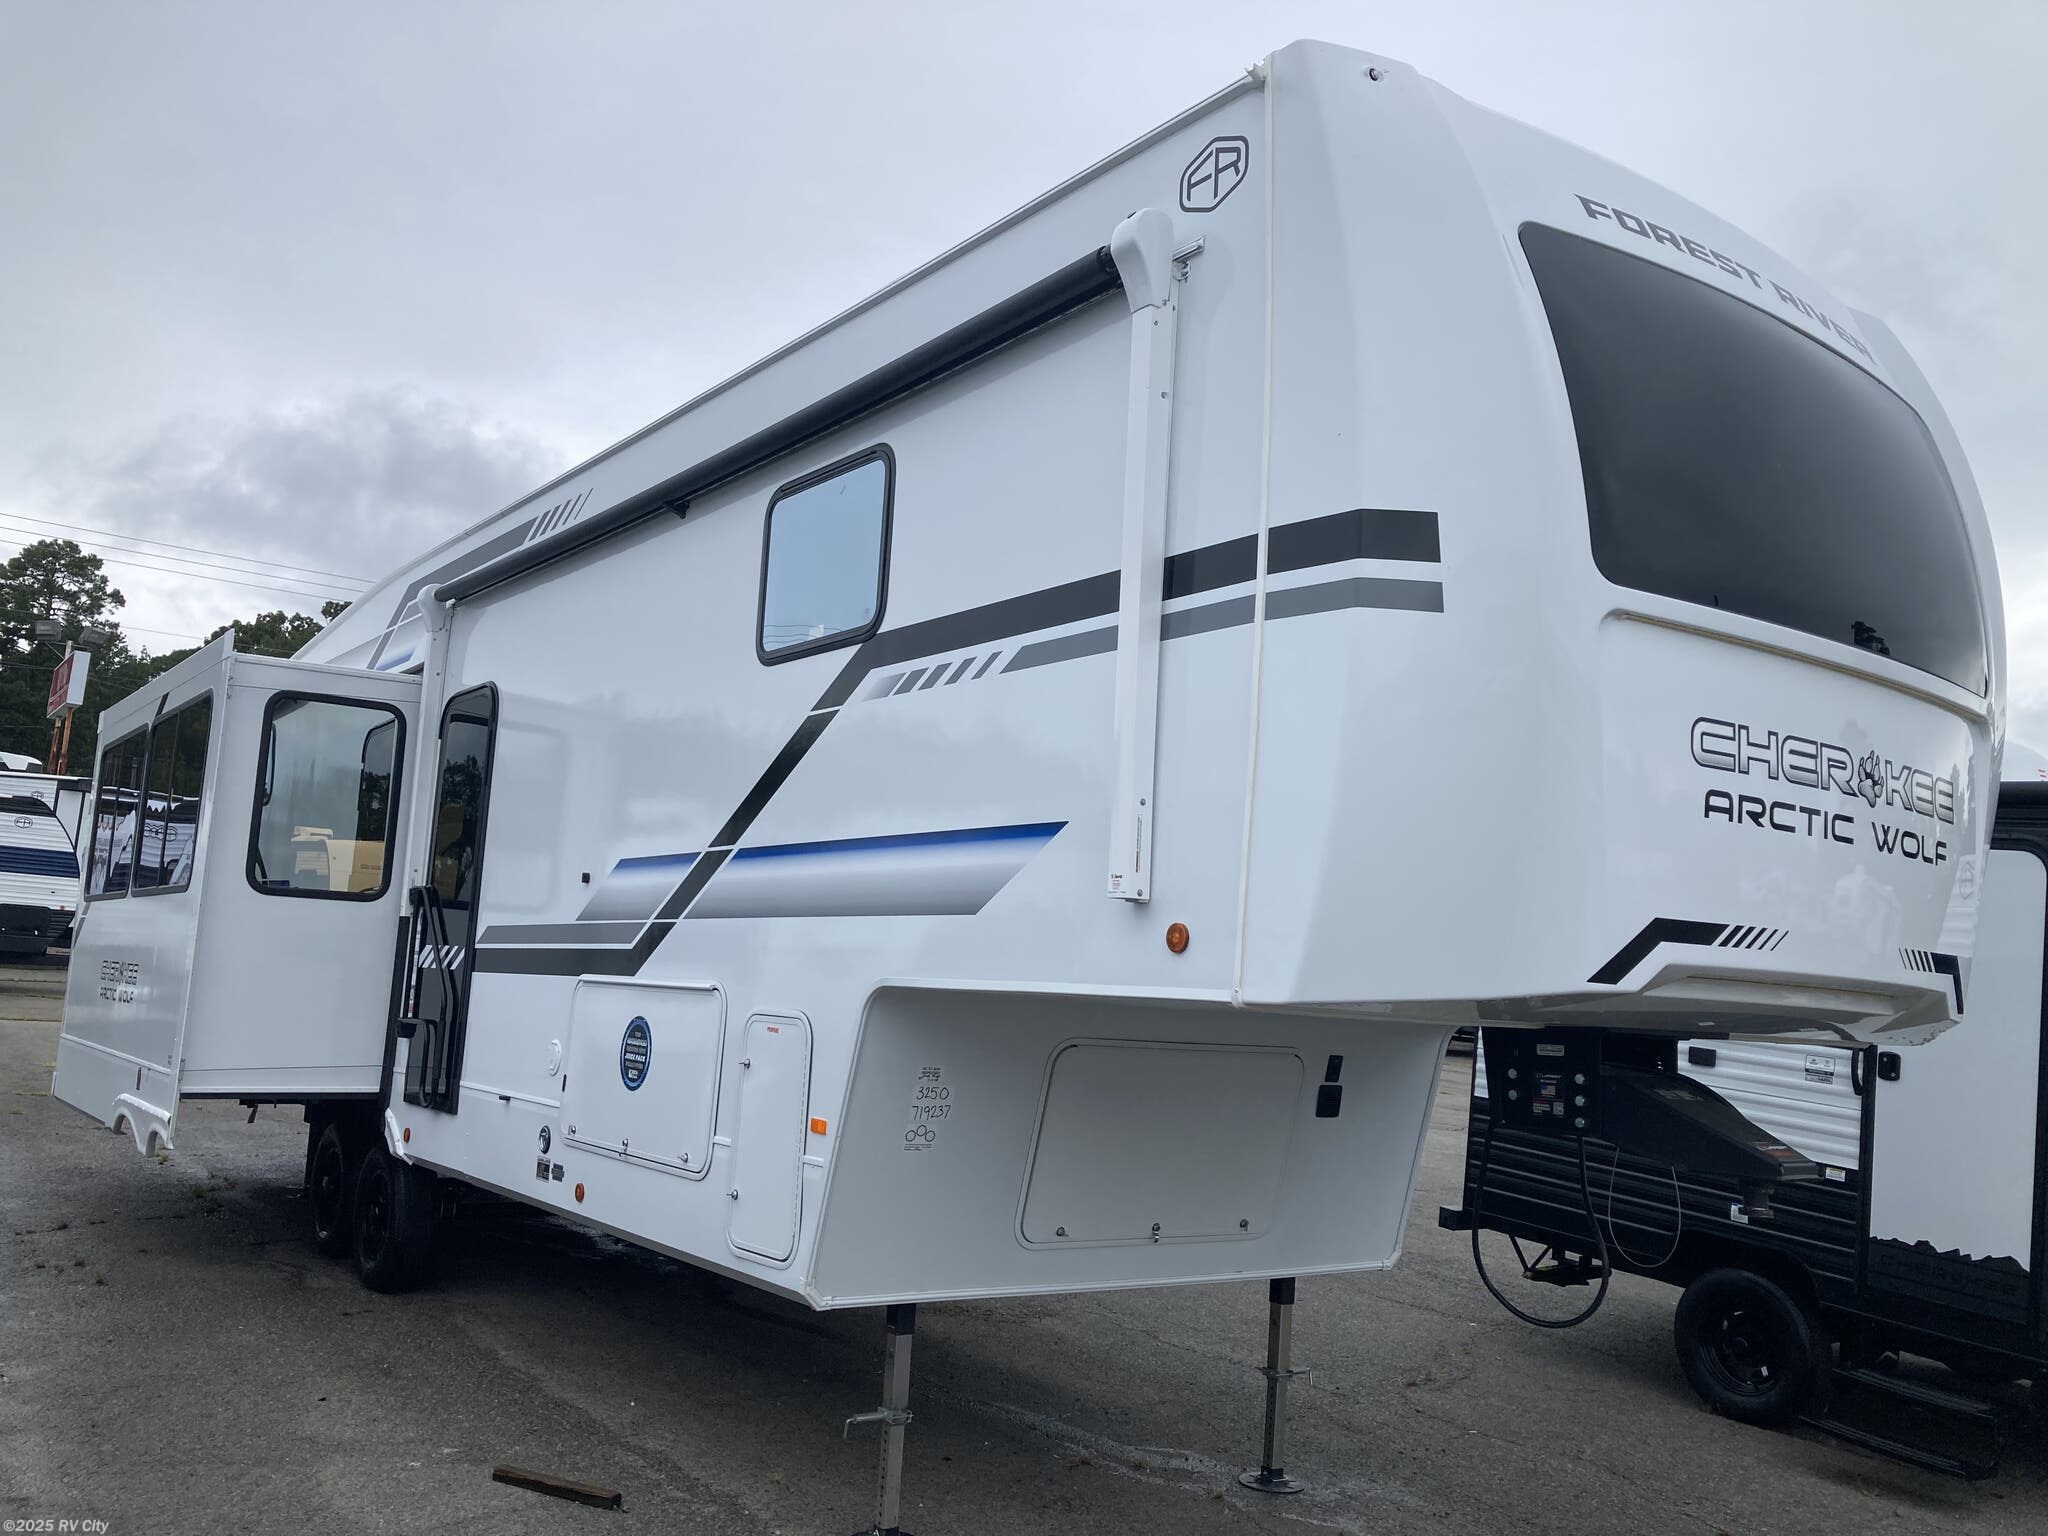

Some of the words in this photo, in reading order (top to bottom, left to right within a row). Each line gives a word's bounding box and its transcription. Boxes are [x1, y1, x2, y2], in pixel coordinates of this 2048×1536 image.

[1573, 193, 1763, 289] FOREST
[1767, 278, 1879, 367] RIVER
[1704, 788, 1855, 845] ARCTIC
[1871, 820, 1947, 866] WOLF
[911, 1104, 952, 1121] 719237
[916, 1086, 950, 1101] 3250
